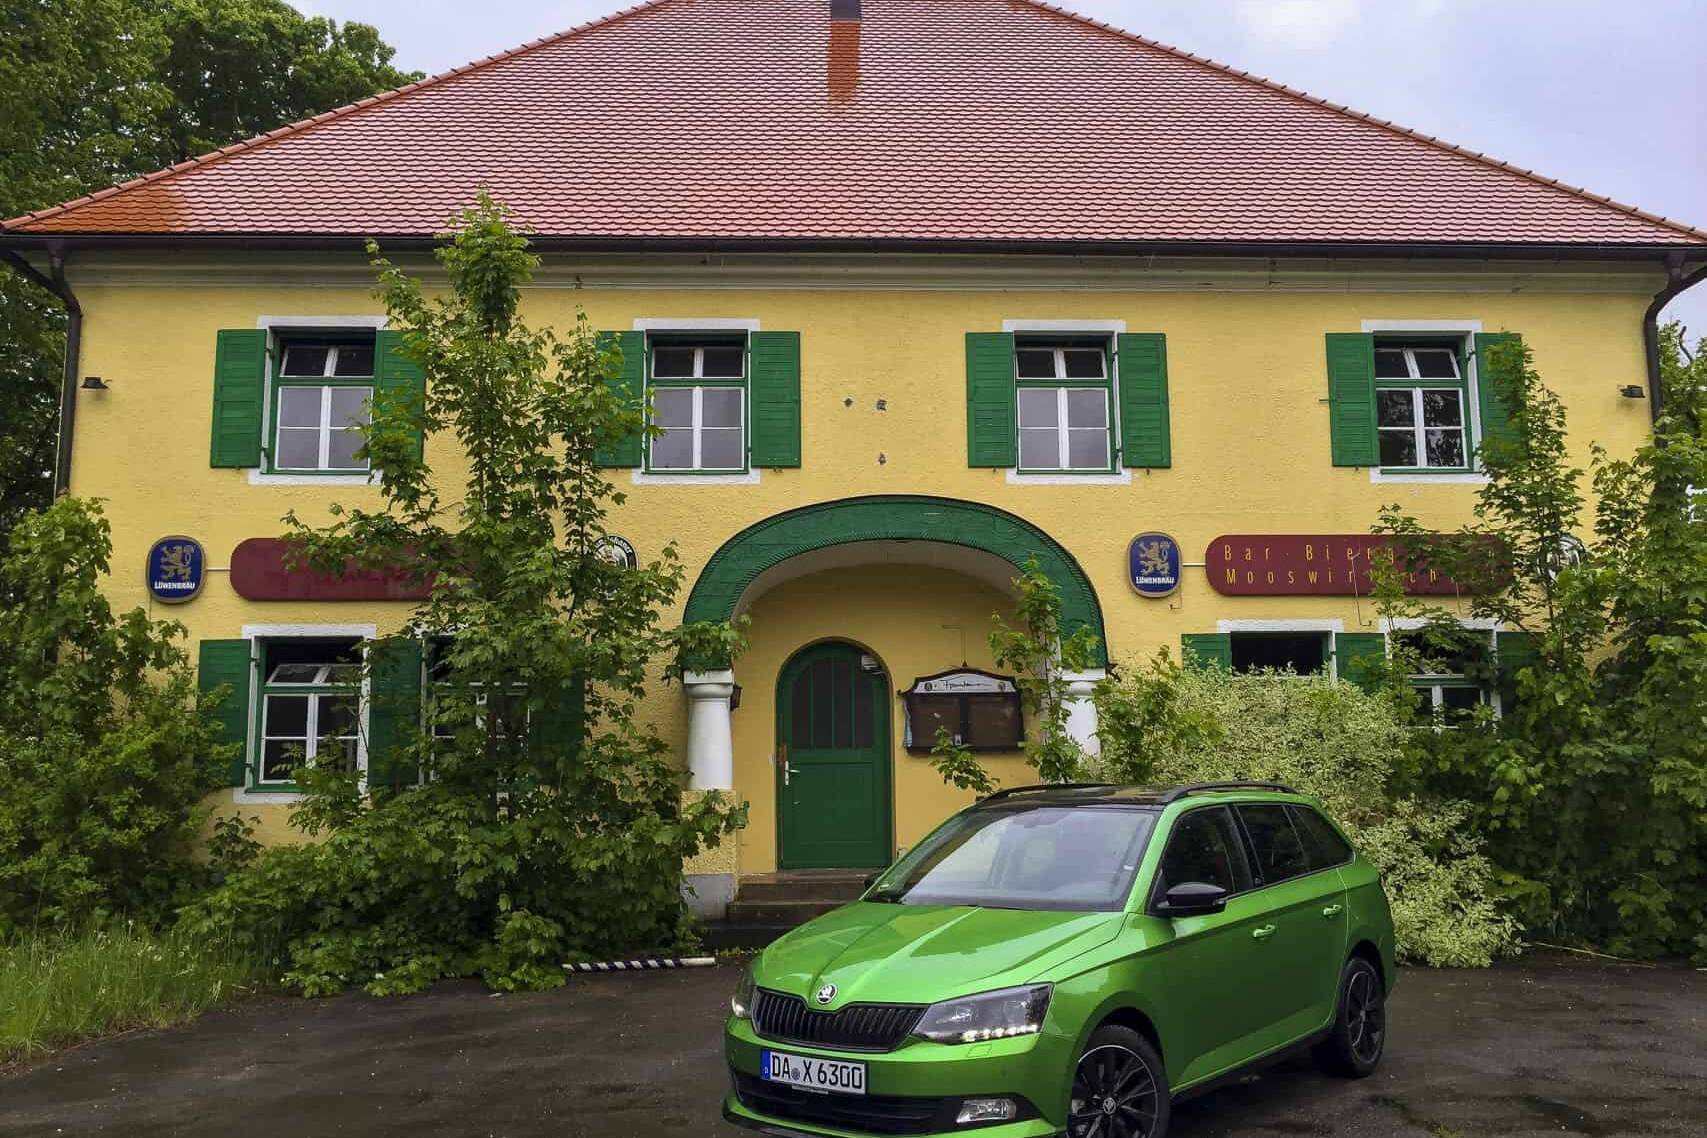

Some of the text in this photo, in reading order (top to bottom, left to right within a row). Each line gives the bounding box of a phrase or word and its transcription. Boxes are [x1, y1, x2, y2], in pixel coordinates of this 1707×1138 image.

[1224, 544, 1270, 561] Bar
[772, 1055, 862, 1089] DA X 6300
